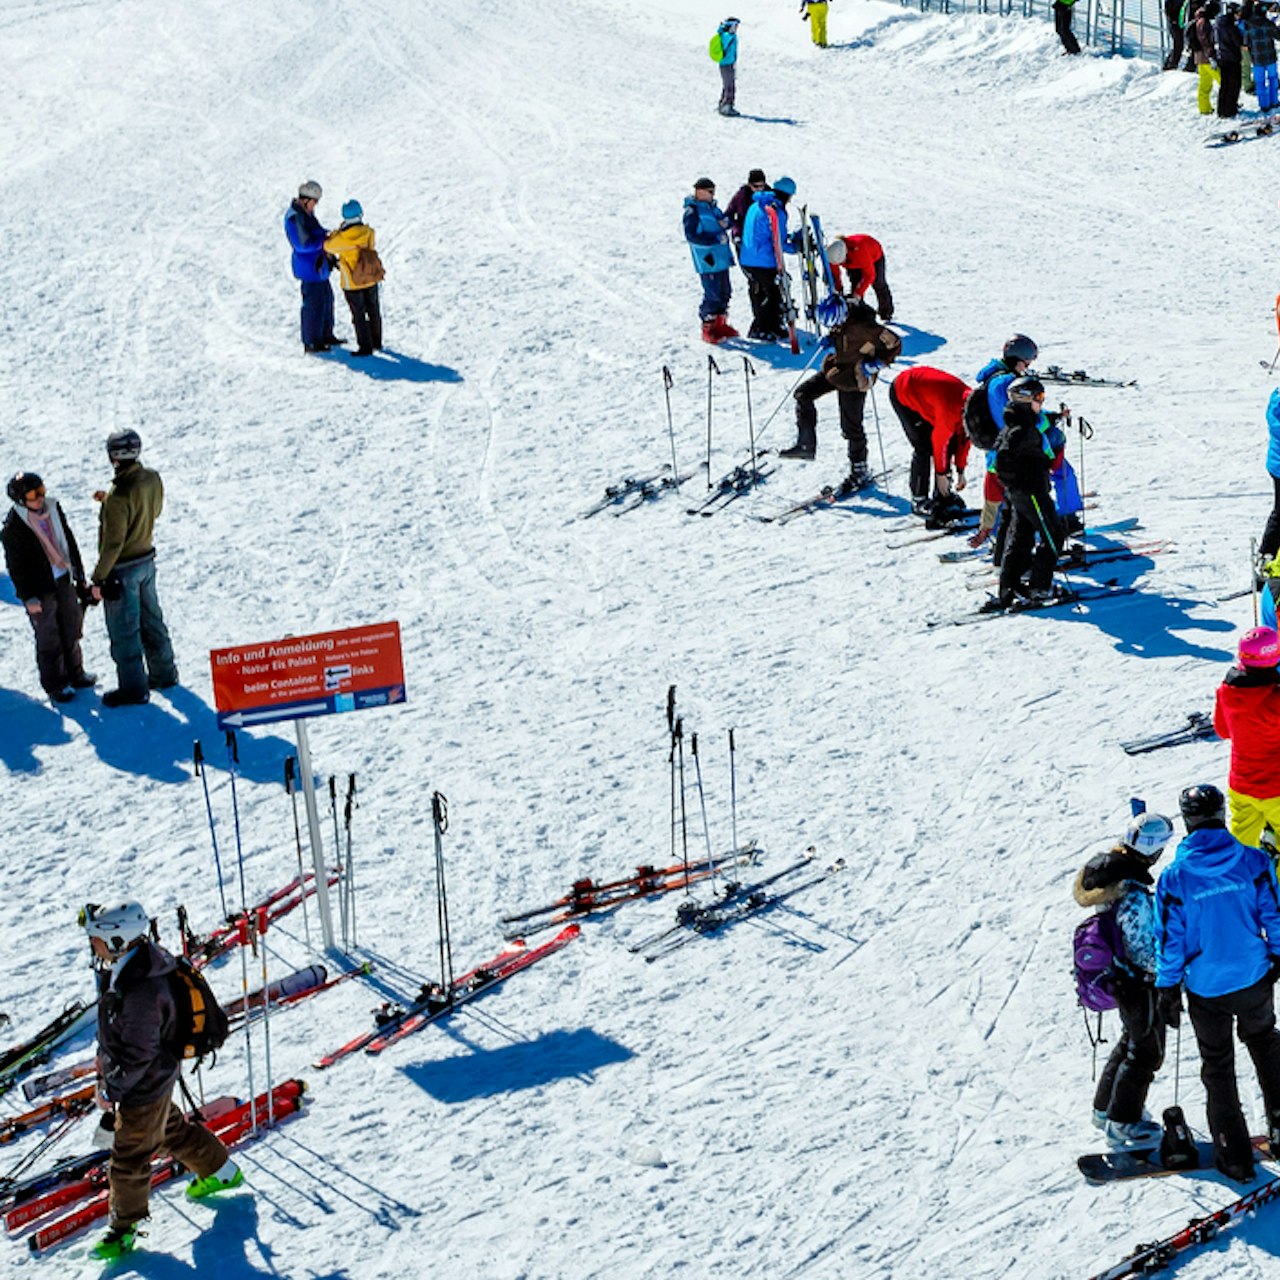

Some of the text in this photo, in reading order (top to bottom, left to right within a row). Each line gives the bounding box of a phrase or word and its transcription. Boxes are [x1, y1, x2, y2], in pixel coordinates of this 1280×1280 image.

[361, 631, 396, 643] registration
[216, 637, 334, 665] Info und Anmeldung
[360, 646, 379, 656] Palace
[242, 654, 317, 675] Natur Eis Palast
[244, 664, 375, 693] beim Container links
